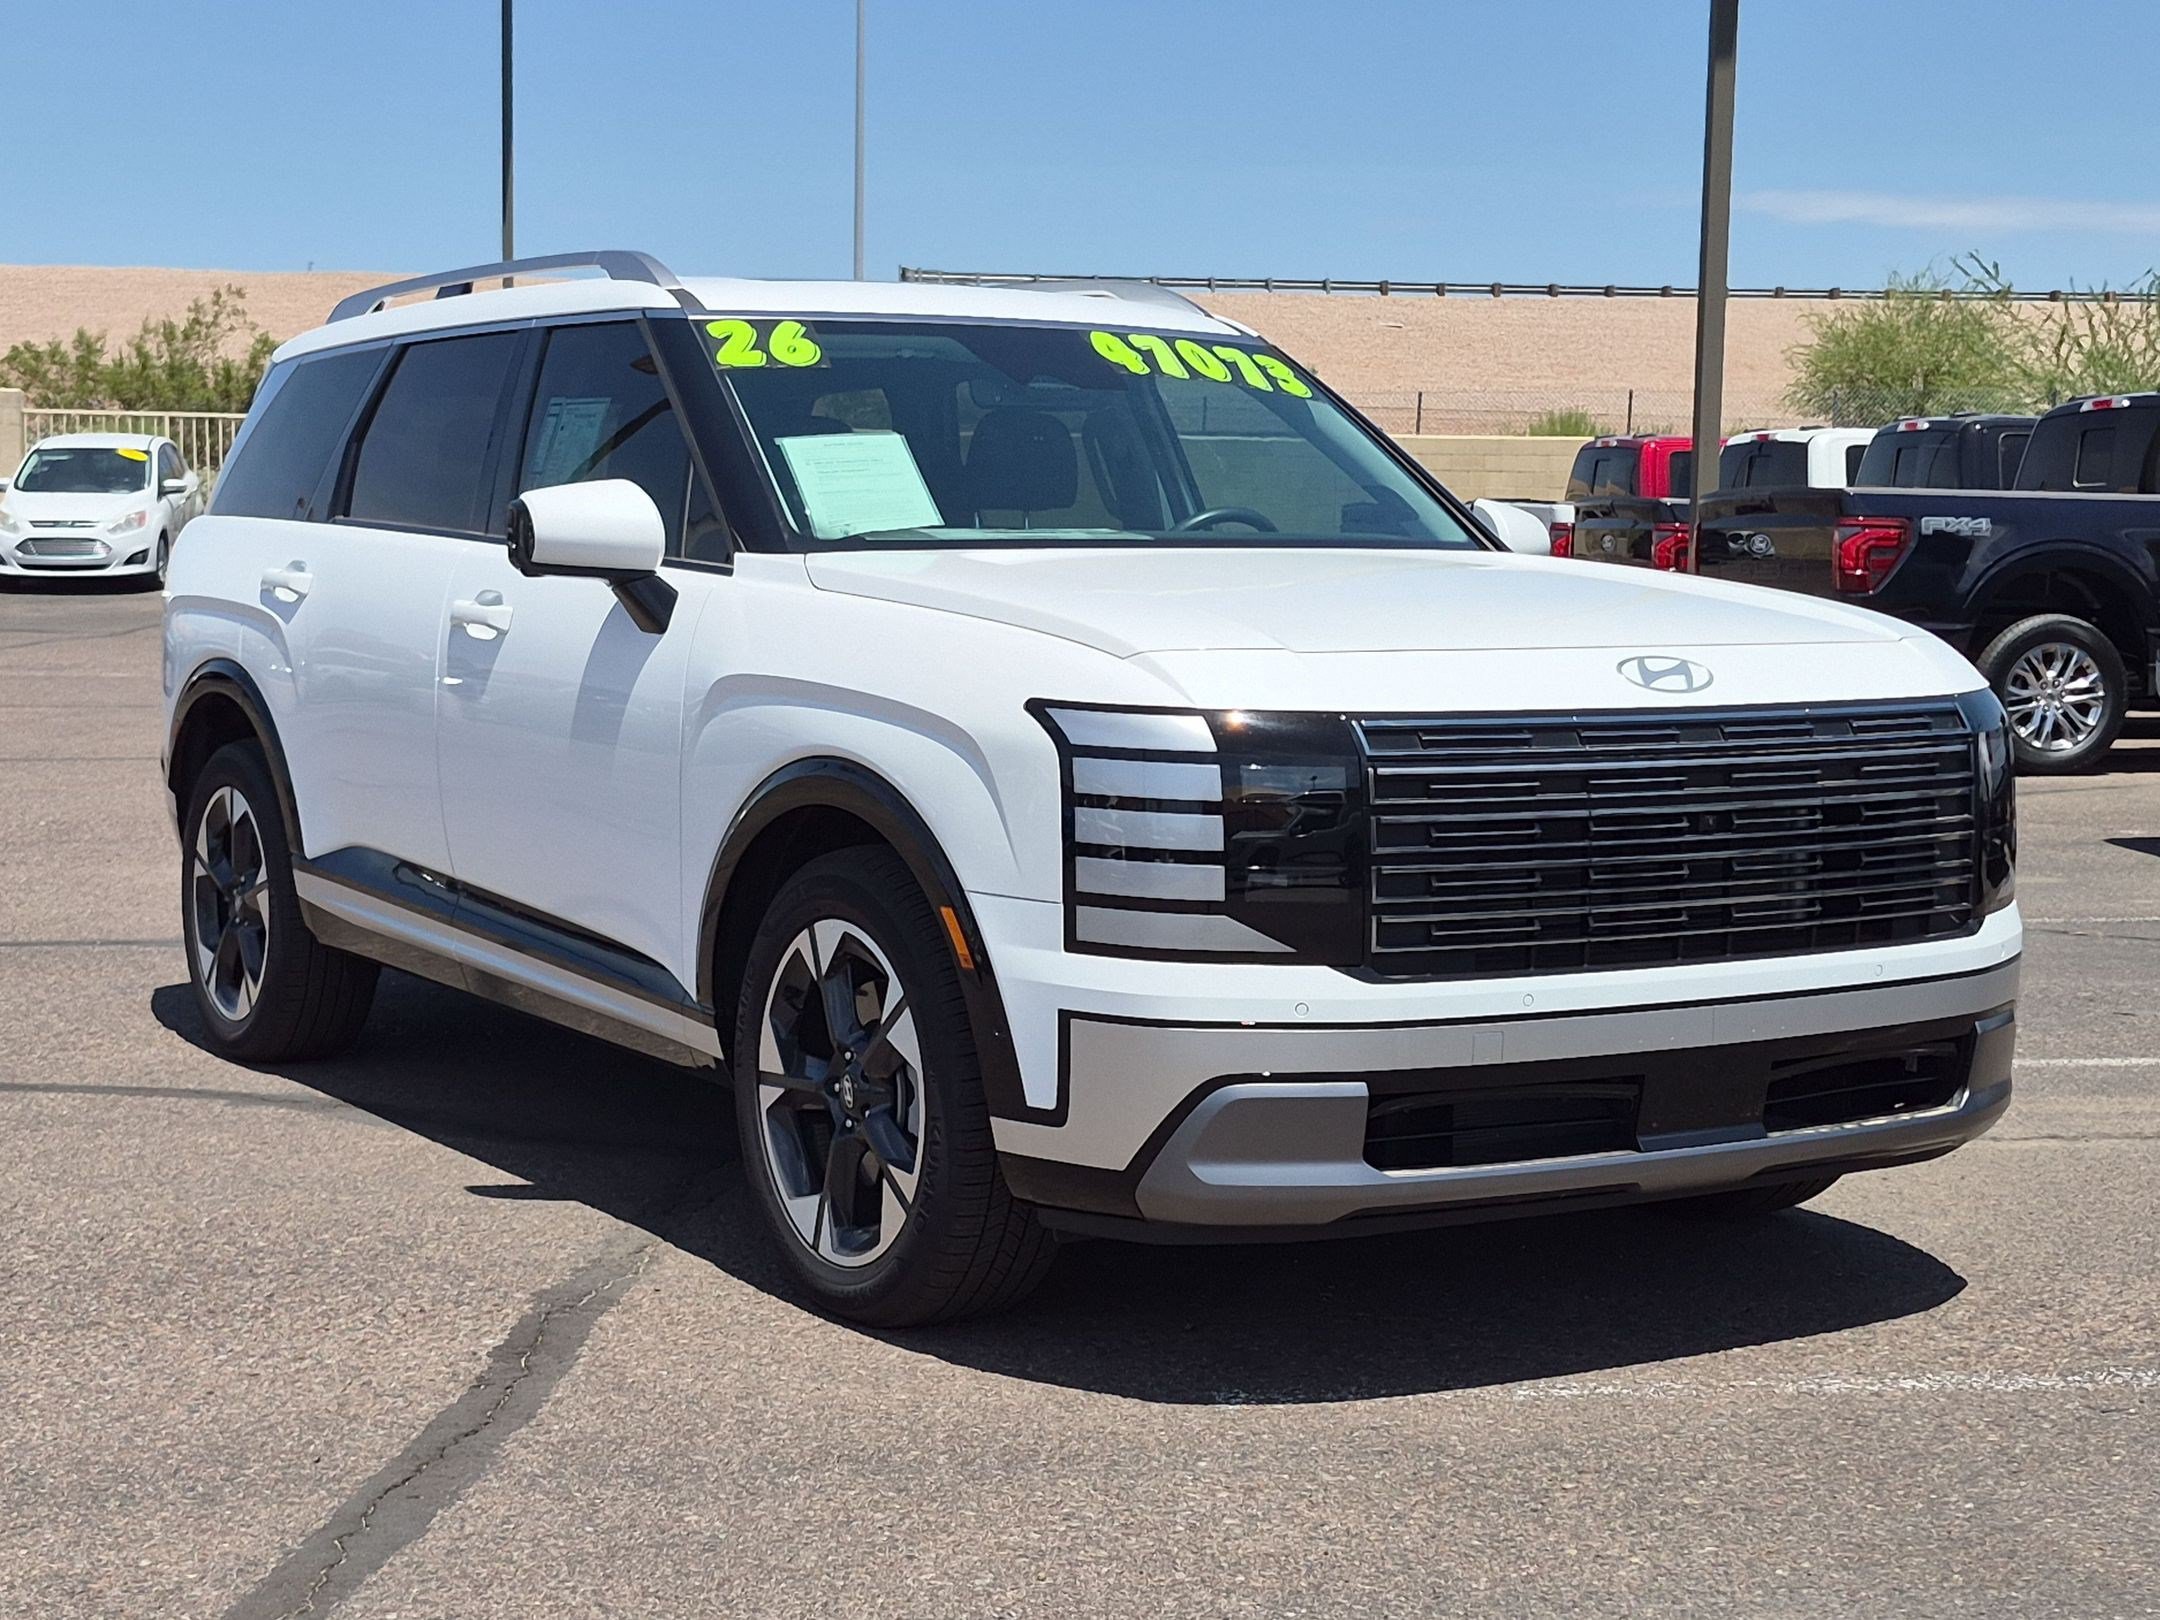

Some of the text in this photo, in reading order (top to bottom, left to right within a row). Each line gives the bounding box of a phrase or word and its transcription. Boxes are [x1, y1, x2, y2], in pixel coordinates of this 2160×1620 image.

[705, 319, 821, 368] 26
[1089, 330, 1313, 398] 47073
[1921, 516, 1992, 537] FX4
